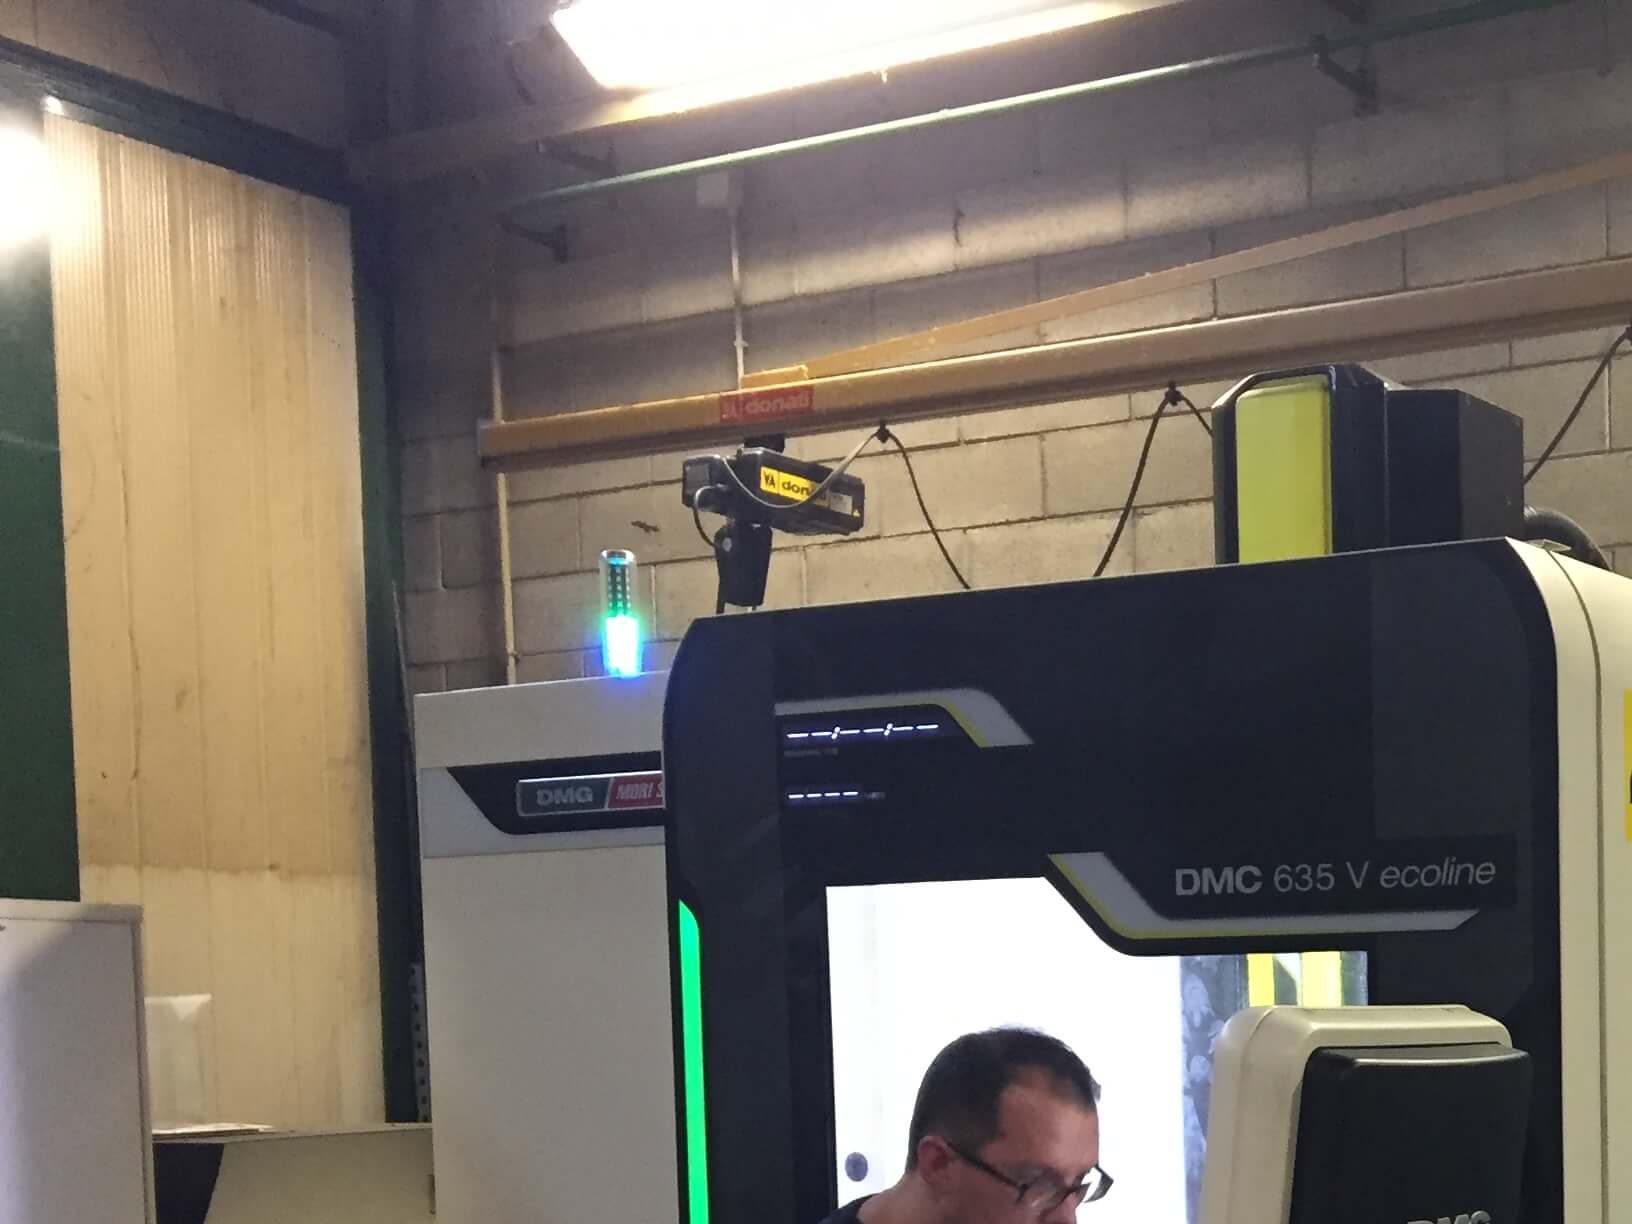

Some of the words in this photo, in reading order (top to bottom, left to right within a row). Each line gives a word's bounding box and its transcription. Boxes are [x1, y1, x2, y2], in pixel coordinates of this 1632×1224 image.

[536, 786, 593, 806] DMG
[1175, 865, 1263, 896] DMC
[1273, 864, 1336, 892] 635
[1346, 861, 1370, 889] V
[1379, 856, 1497, 888] ecoline
